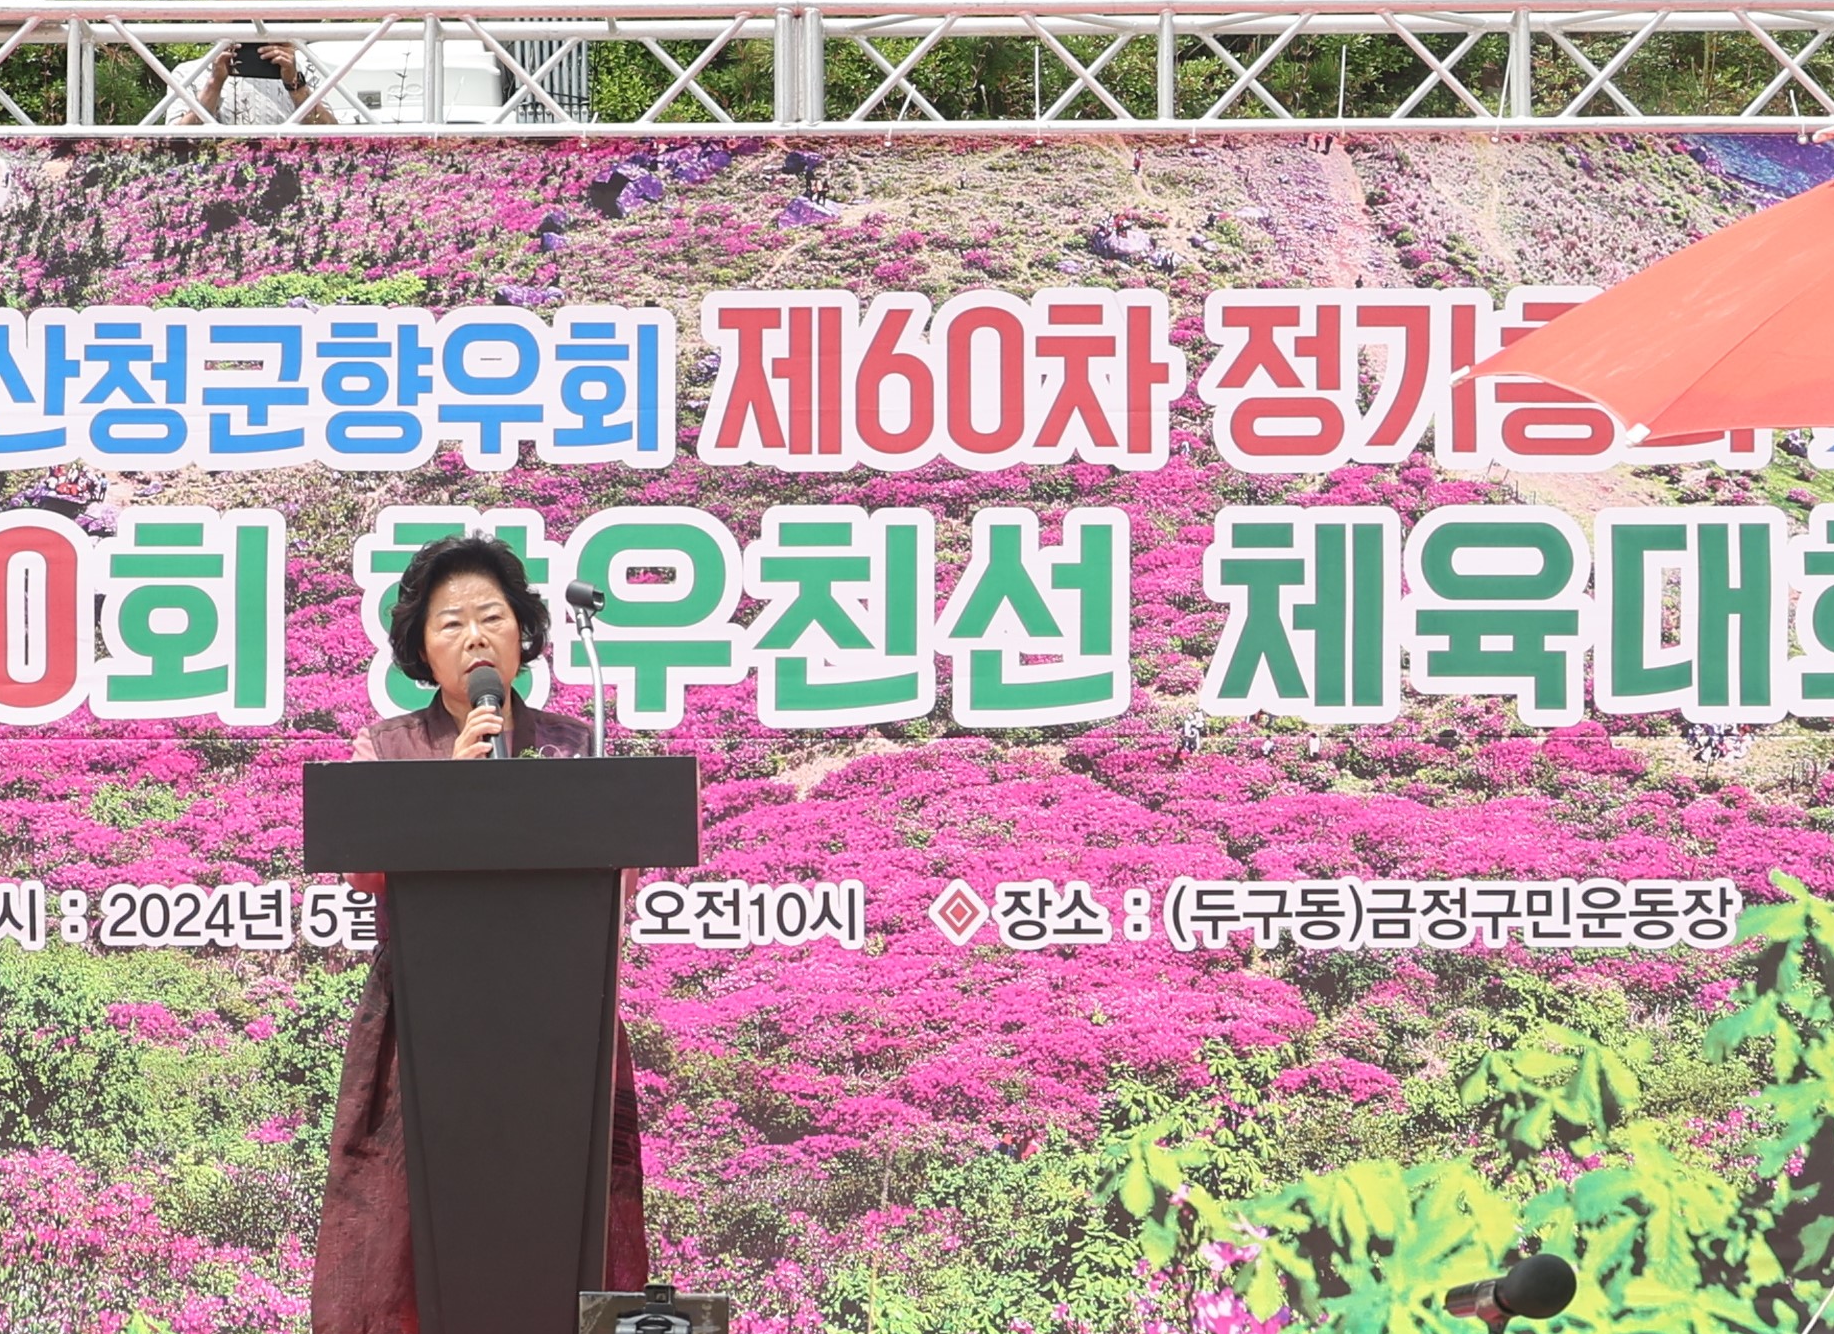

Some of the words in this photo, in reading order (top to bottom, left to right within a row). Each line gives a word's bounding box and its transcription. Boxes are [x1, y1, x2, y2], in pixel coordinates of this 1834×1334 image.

[717, 304, 1169, 456] 제60차
[1216, 303, 1758, 454] 정기총
[106, 888, 285, 940] 2024년
[639, 886, 862, 942] 오전10시
[1000, 887, 1108, 942] 장소
[1166, 885, 1735, 947] (두구동)금정구민운동장
